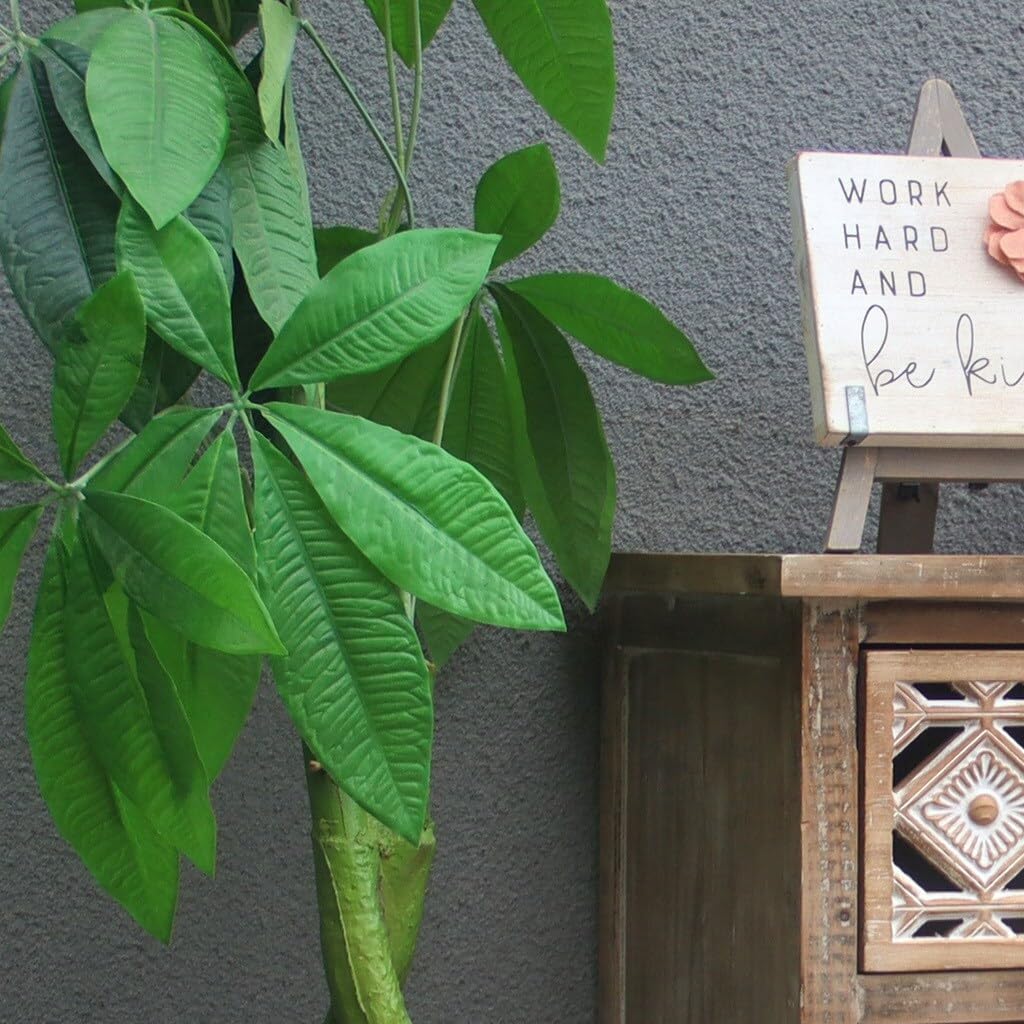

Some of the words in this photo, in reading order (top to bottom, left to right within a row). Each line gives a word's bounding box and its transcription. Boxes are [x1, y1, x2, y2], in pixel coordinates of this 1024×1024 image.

[838, 177, 952, 207] WORK
[842, 223, 950, 253] HARD
[850, 269, 927, 298] AND
[860, 304, 936, 397] be
